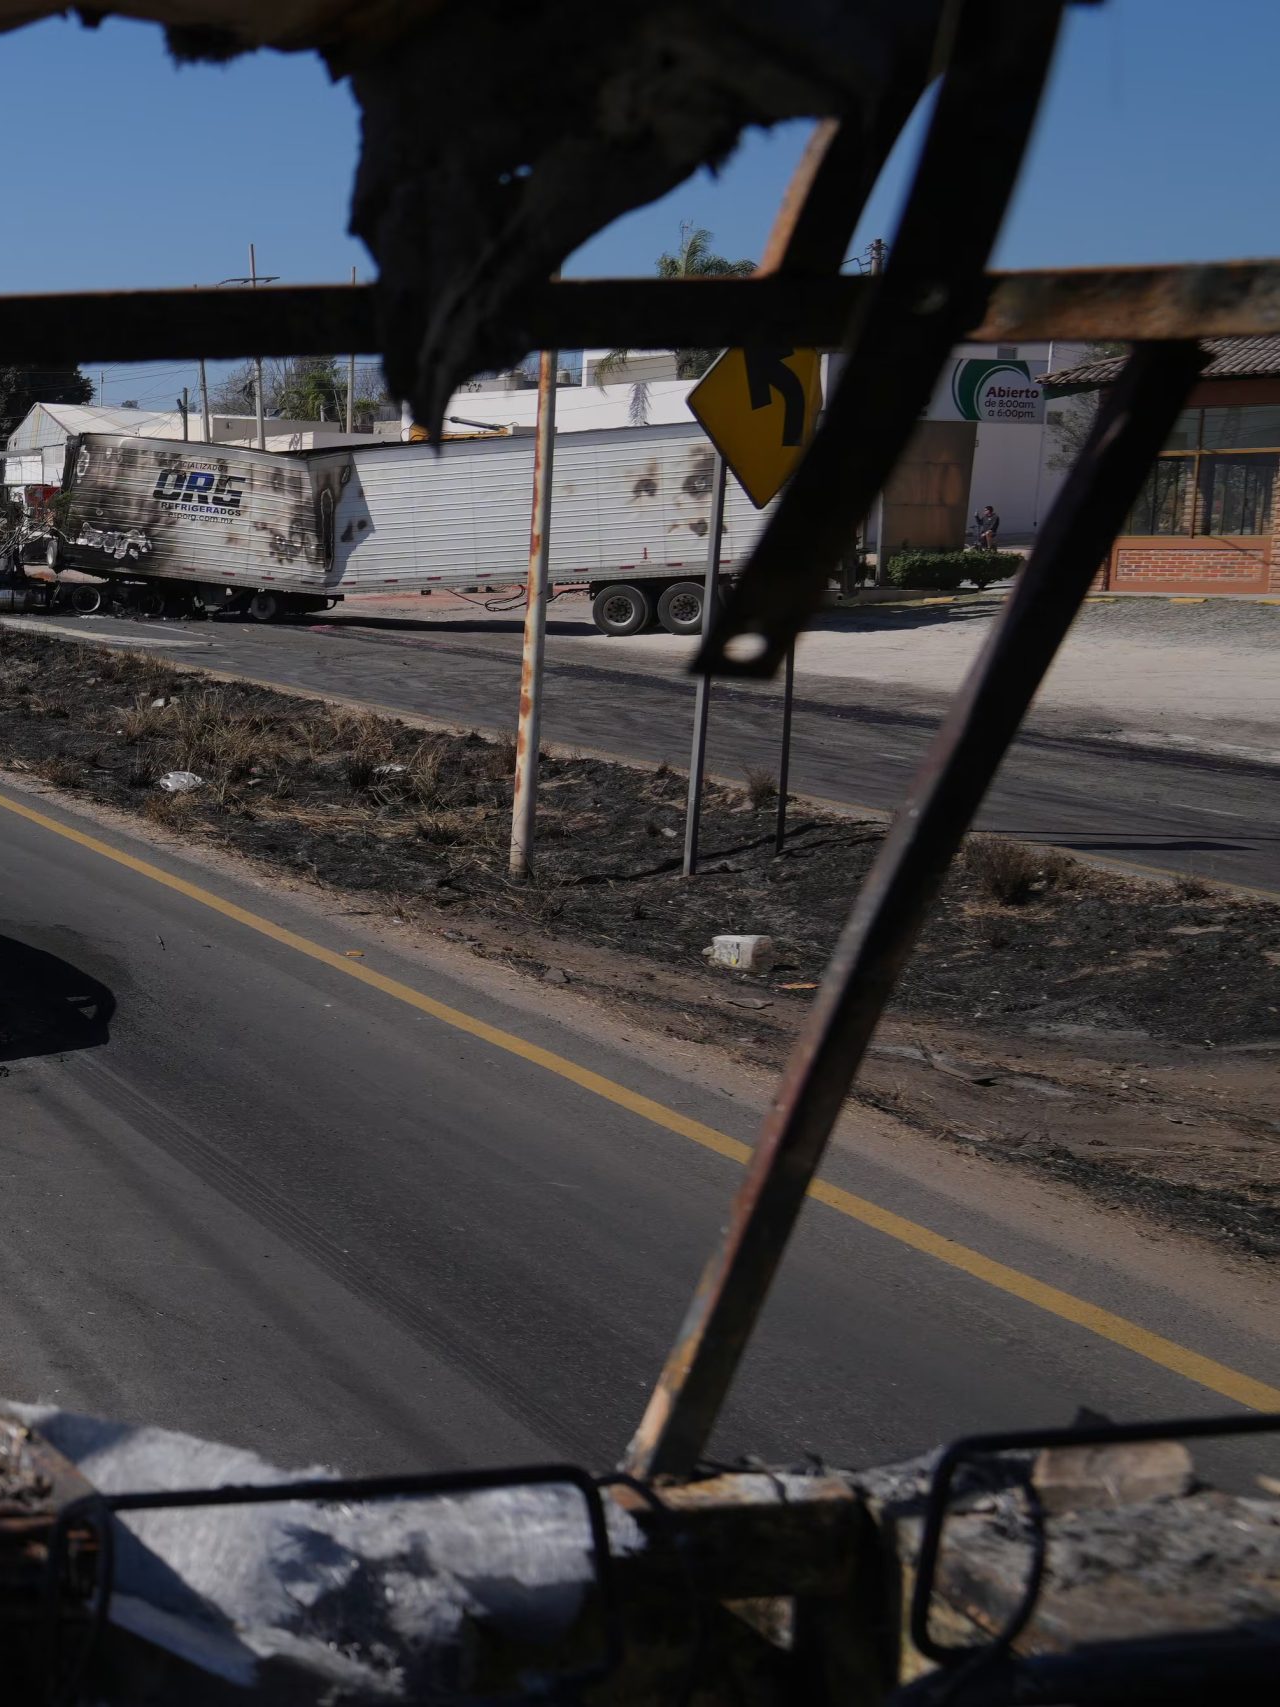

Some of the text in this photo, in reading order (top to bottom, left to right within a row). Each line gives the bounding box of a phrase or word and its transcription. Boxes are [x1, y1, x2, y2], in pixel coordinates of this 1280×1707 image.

[985, 386, 1039, 398] Abierto
[984, 399, 997, 408] de
[163, 460, 228, 472] ECIALIZADOS
[152, 468, 246, 508] ORG
[161, 502, 242, 517] REFRIGERADOS
